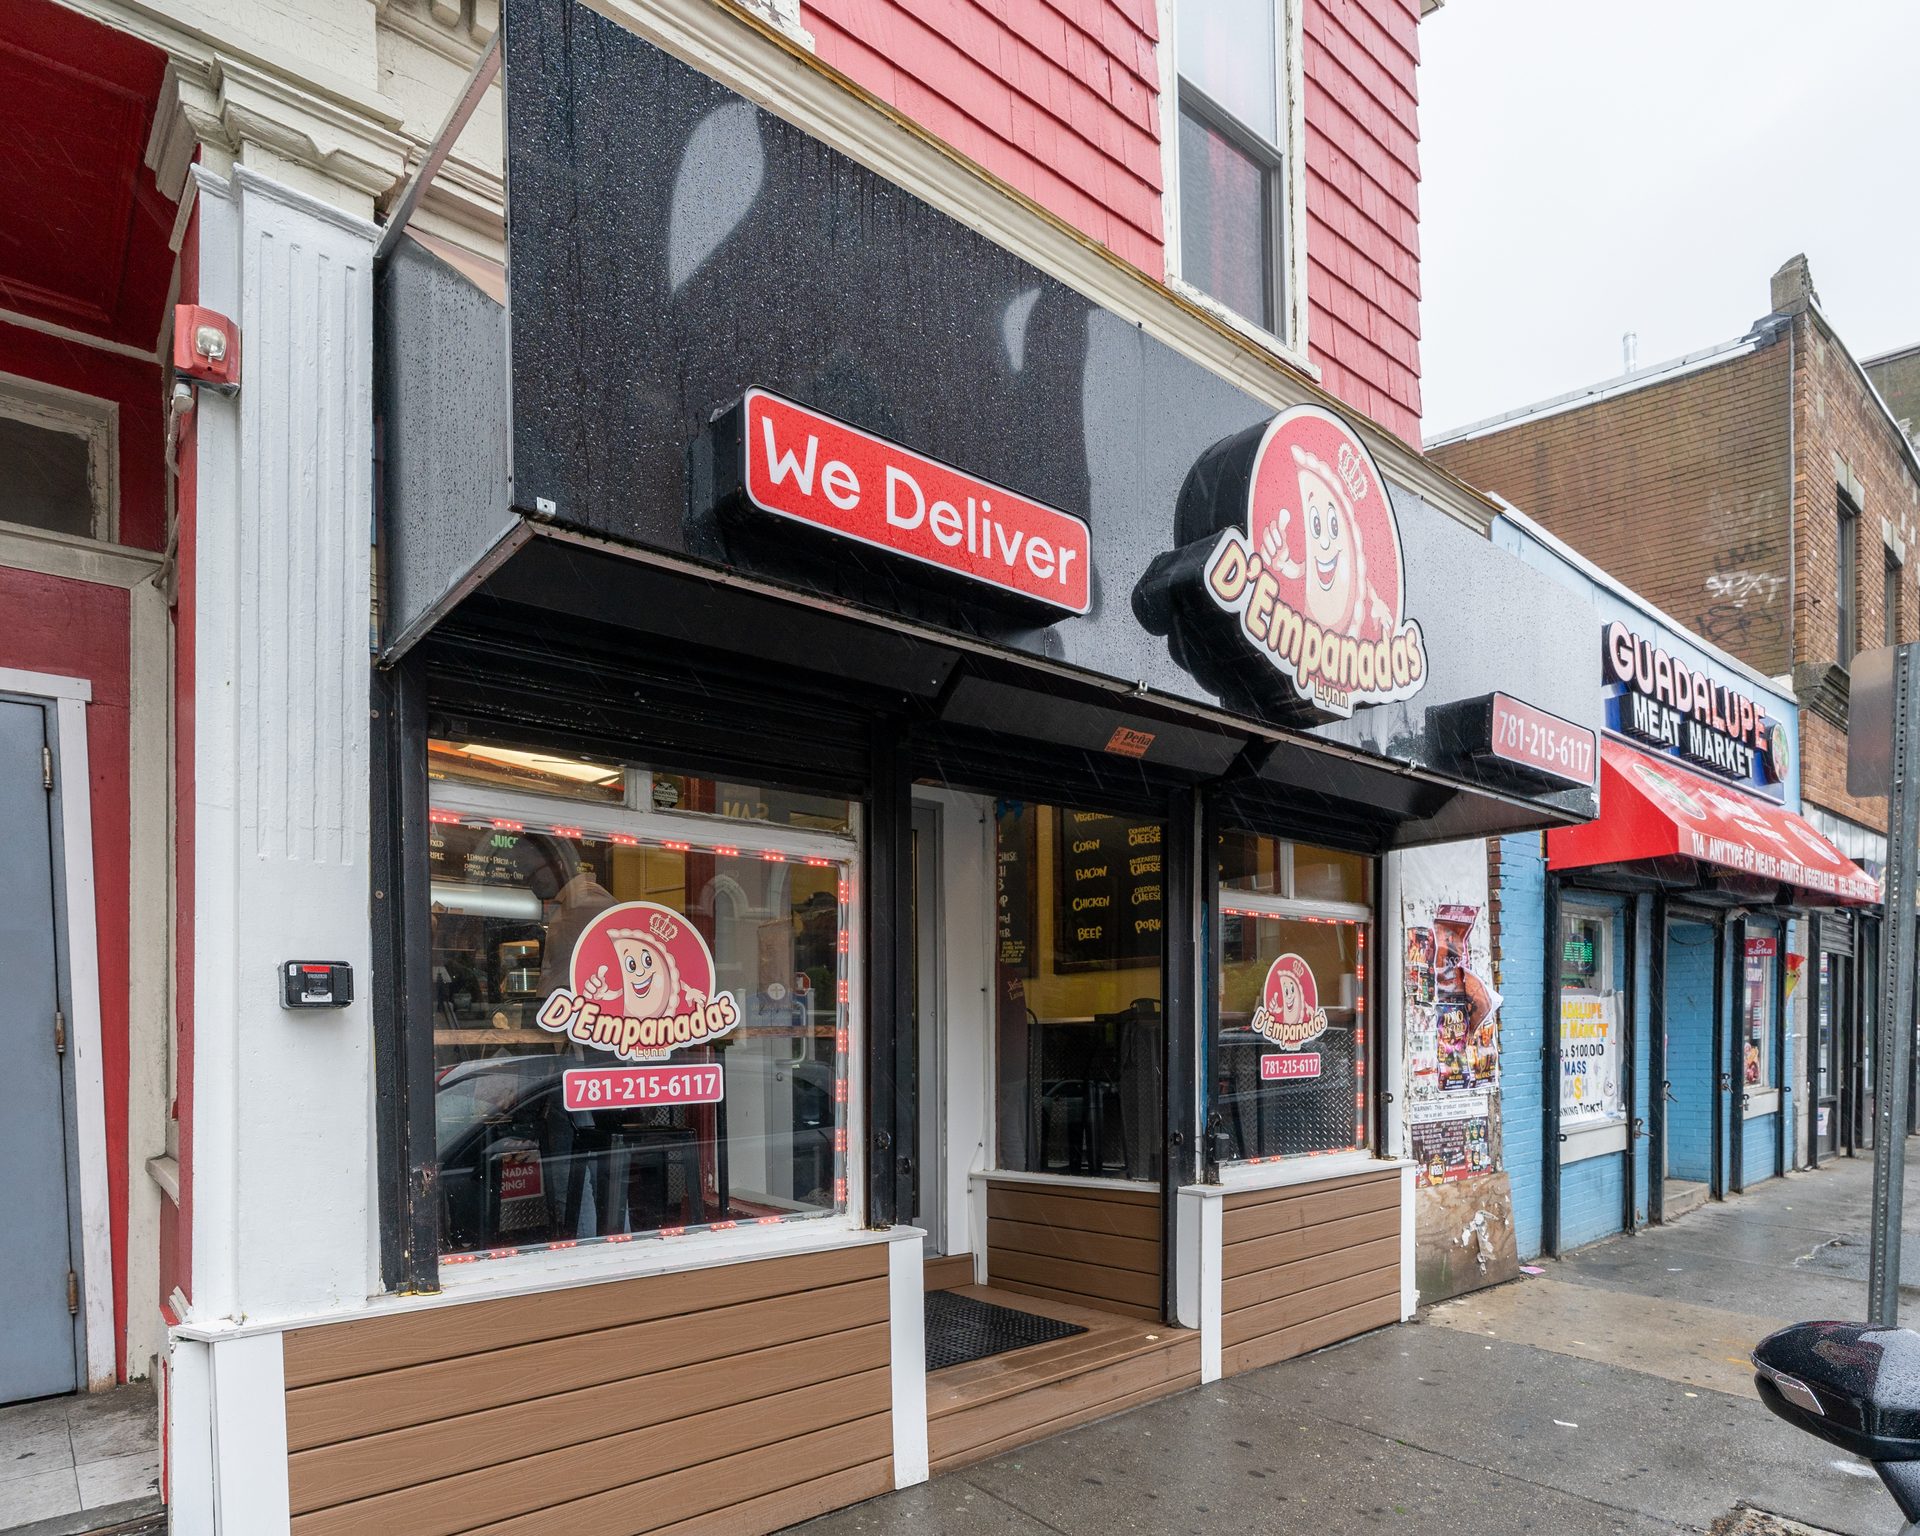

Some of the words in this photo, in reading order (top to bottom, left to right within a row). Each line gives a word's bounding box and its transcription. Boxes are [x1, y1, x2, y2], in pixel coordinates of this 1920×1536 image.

[761, 415, 861, 510] We
[885, 464, 1076, 585] Deliver
[1209, 538, 1423, 692] D'Empanadas
[1313, 679, 1350, 708] Lynn
[1608, 620, 1768, 752] GUADALUPE
[1498, 710, 1592, 774] 781-215-6117
[1632, 691, 1681, 747] MEAT
[1688, 720, 1754, 779] MARKET
[1072, 839, 1101, 854] CORN
[1128, 832, 1161, 846] CHEESE
[1075, 865, 1108, 881] BACON
[1130, 861, 1161, 876] CHEESE
[1725, 842, 1744, 868] TYPE
[1744, 848, 1755, 870] OF
[1755, 851, 1776, 877] MEATS
[1072, 895, 1110, 912] CHICKEN
[1077, 926, 1103, 942] BEEF
[541, 993, 737, 1056] D'Empanadas
[1253, 1009, 1326, 1047] D'Empanadas
[635, 1045, 667, 1058] Lynn
[1264, 1058, 1319, 1075] 781-215-6117
[1564, 1060, 1587, 1076] MASS
[573, 1073, 717, 1103] 781-215-6117
